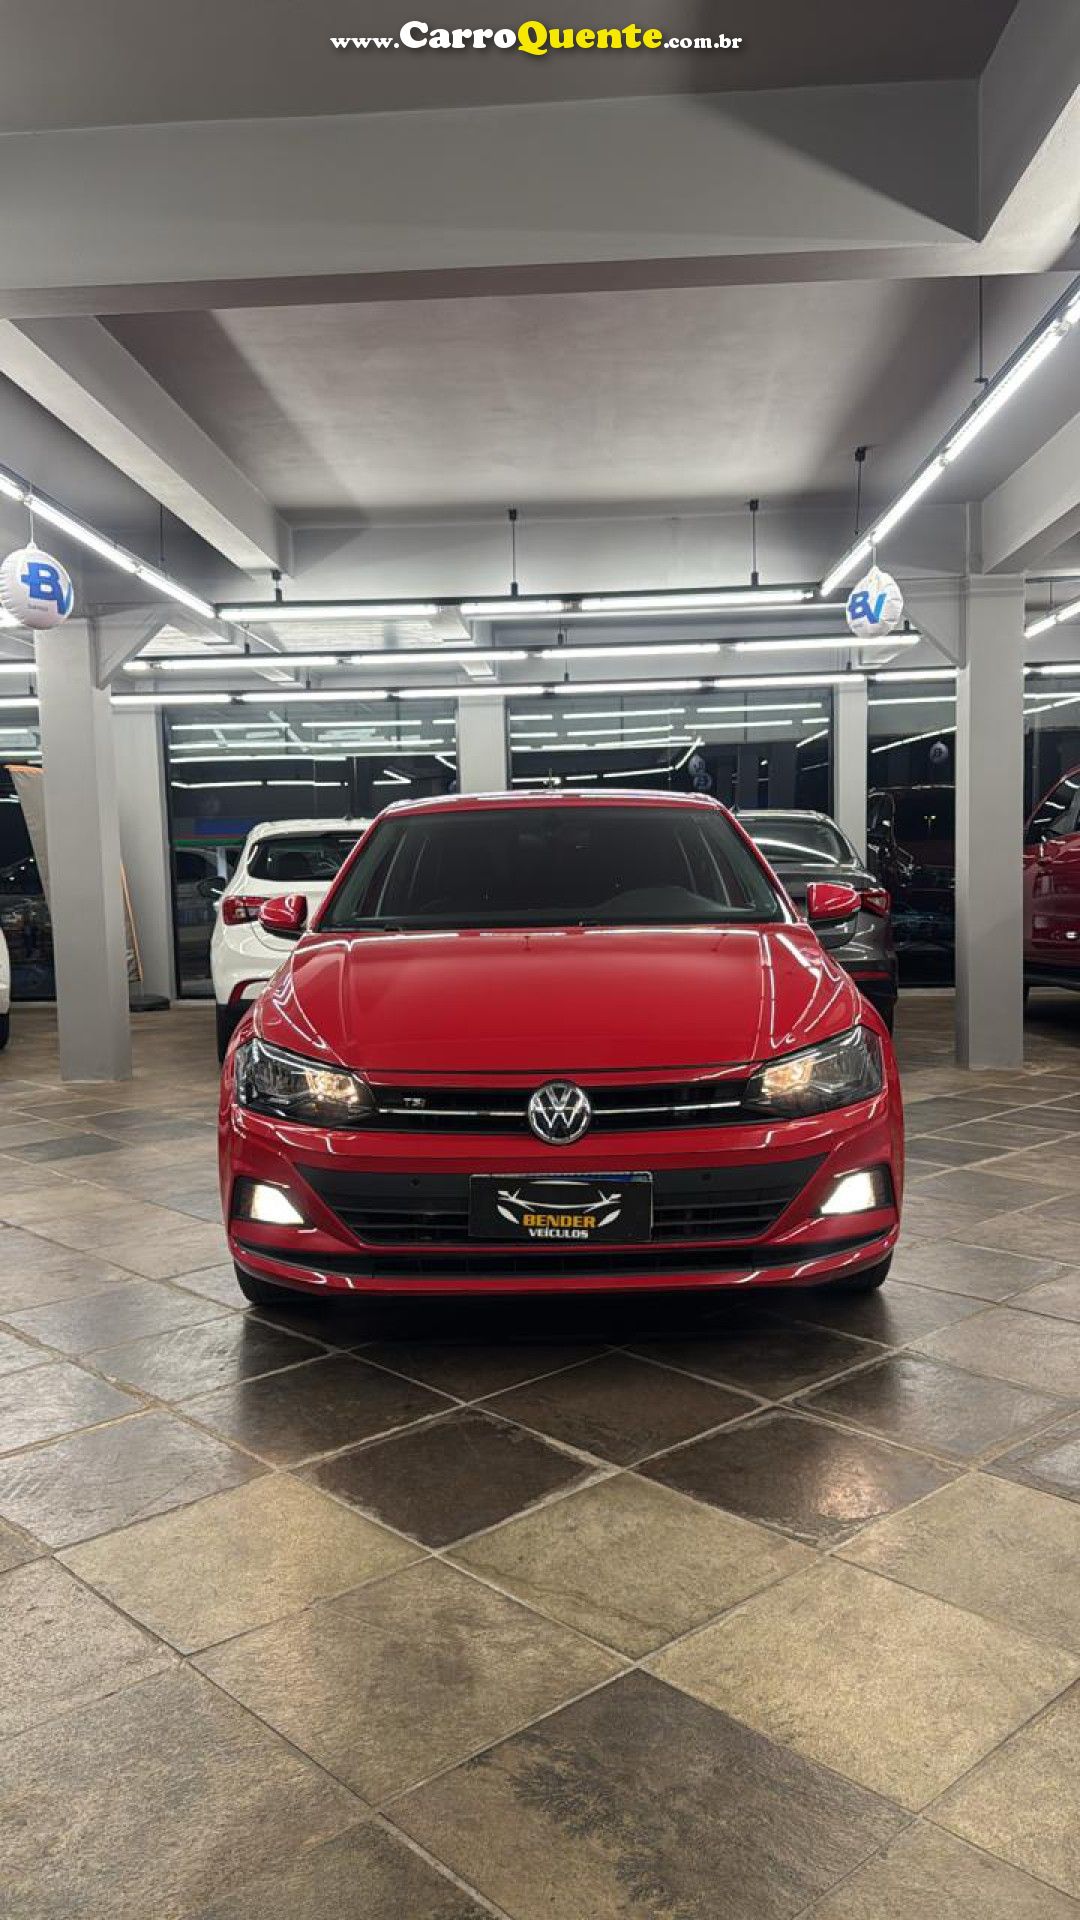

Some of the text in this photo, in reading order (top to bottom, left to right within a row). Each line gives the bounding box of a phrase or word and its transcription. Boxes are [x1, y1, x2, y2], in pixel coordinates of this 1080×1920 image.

[849, 591, 887, 624] BV
[523, 1214, 597, 1228] BENDER
[528, 1227, 589, 1239] VEÍCULOS
